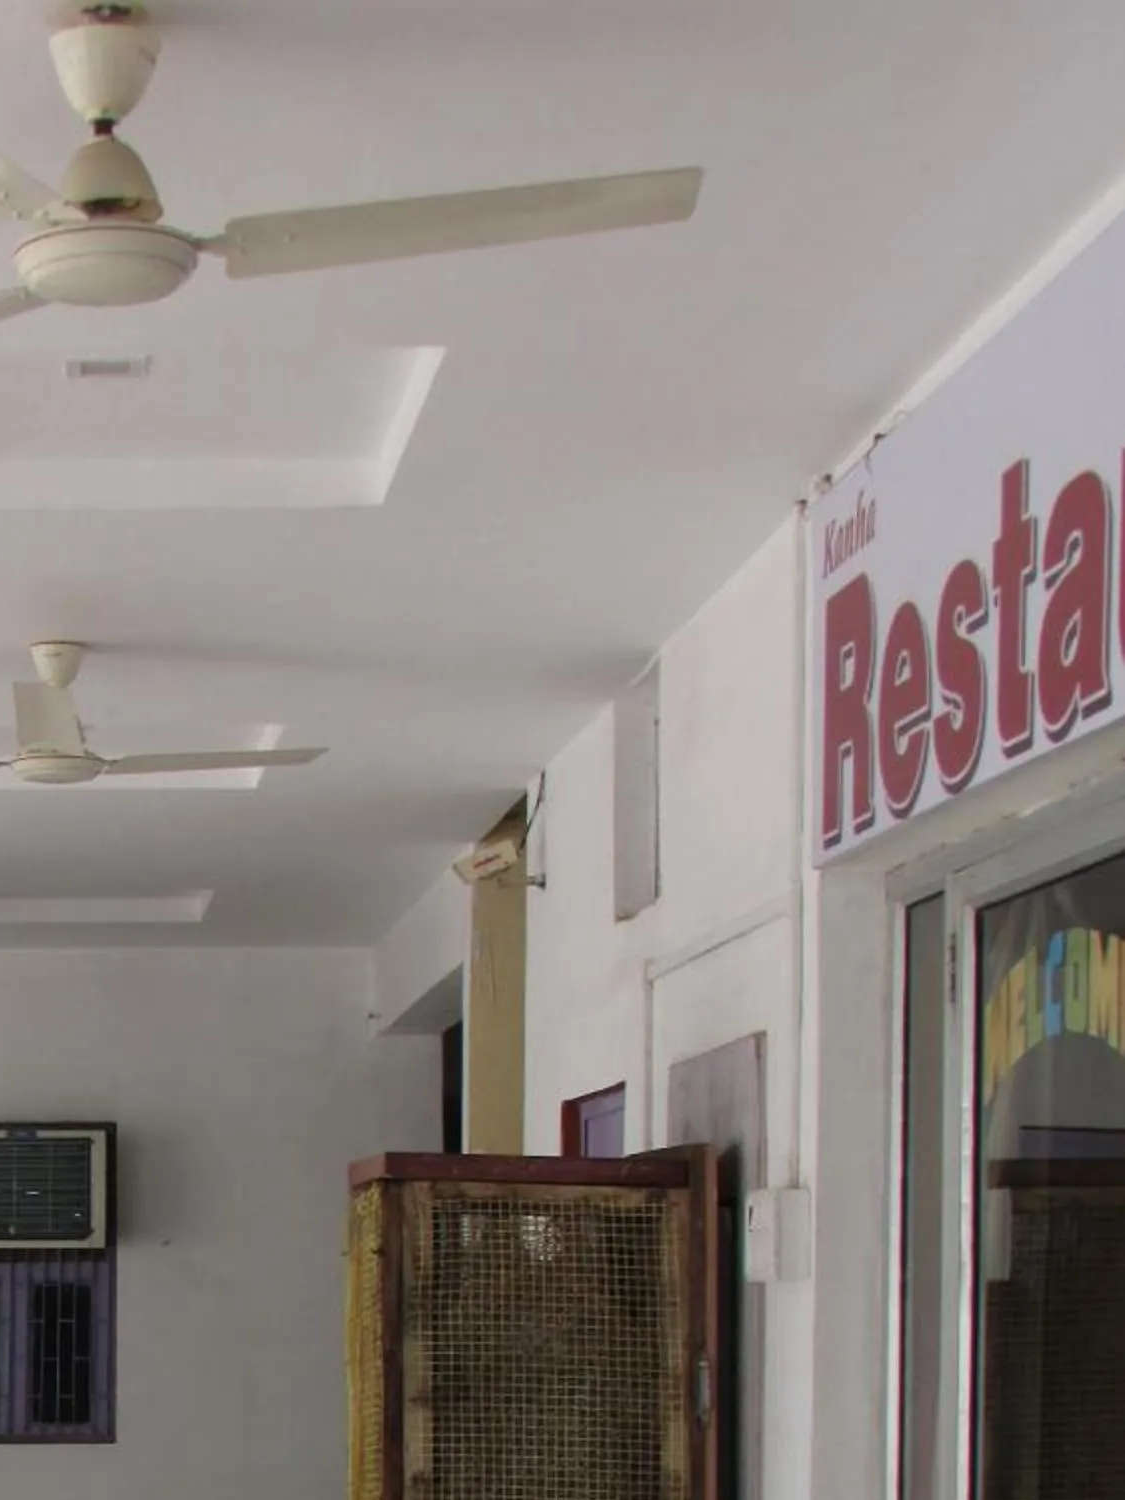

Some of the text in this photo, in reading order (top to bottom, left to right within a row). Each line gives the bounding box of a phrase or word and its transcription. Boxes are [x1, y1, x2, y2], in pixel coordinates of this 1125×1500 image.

[821, 489, 877, 579] Kanha
[821, 447, 1125, 850] Resta
[982, 927, 1125, 1107] WELCOM
